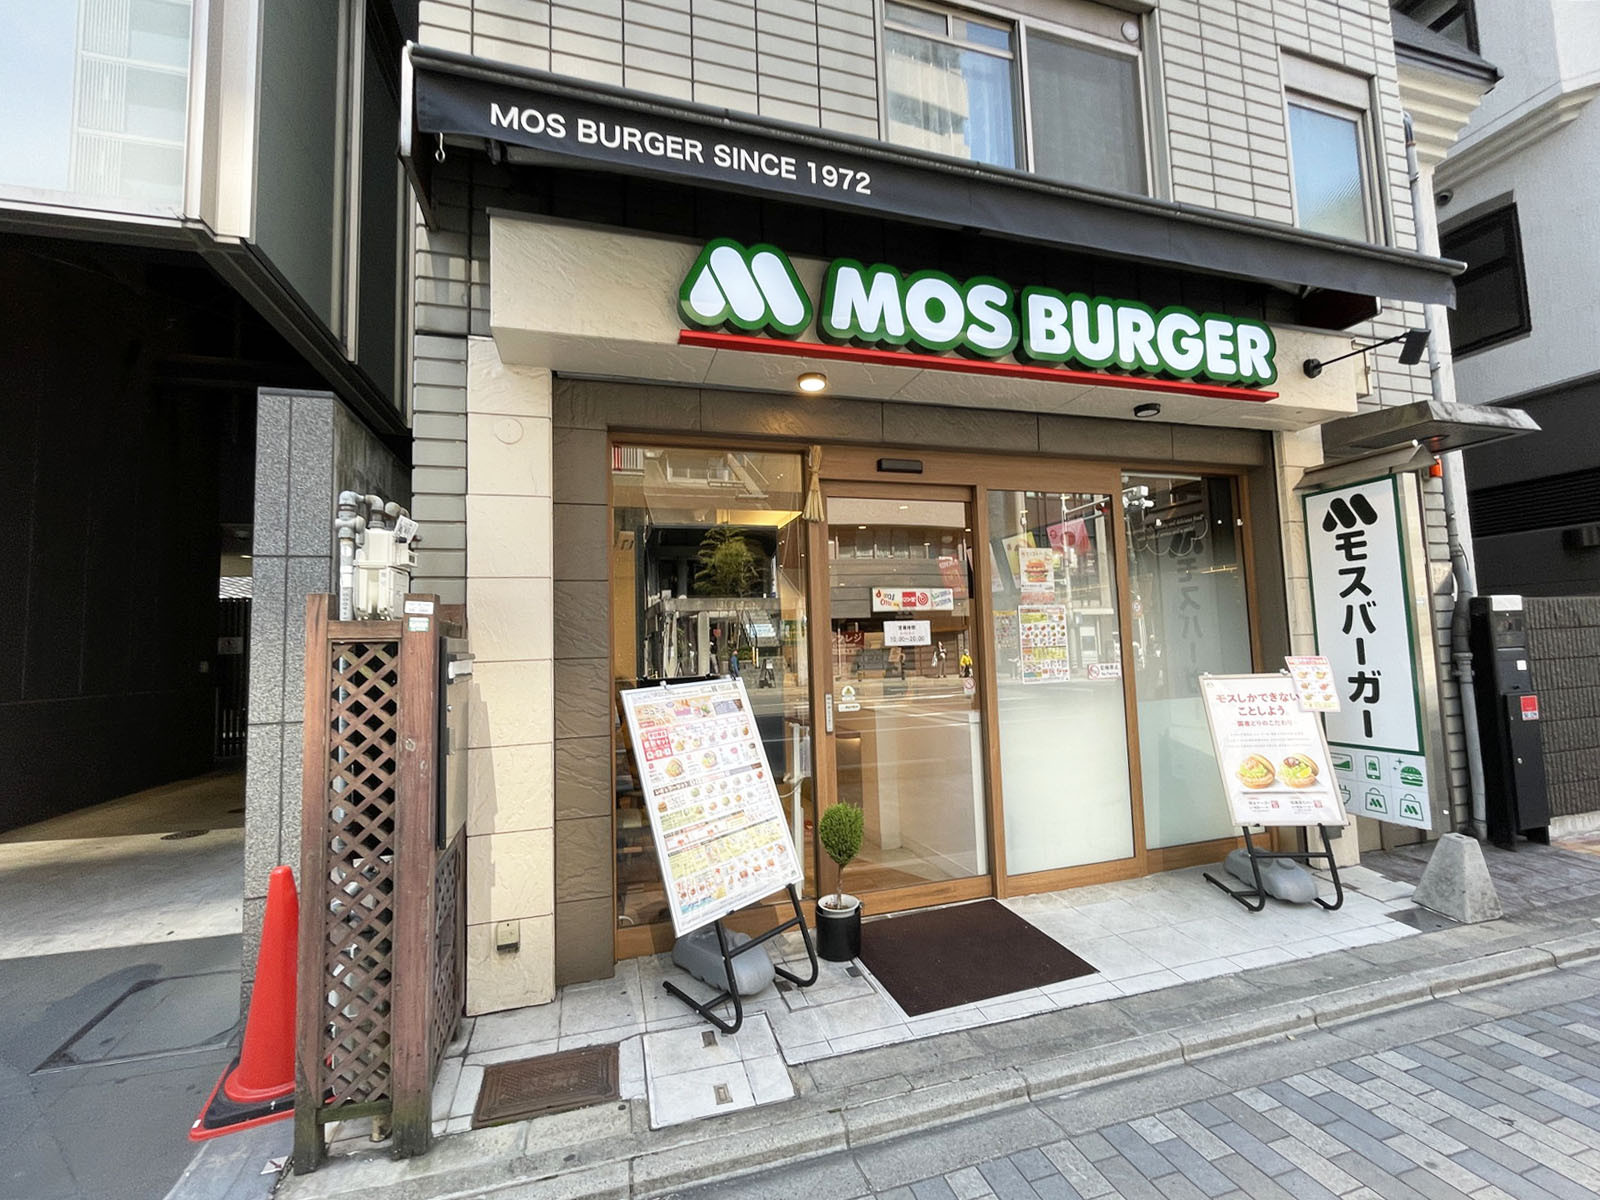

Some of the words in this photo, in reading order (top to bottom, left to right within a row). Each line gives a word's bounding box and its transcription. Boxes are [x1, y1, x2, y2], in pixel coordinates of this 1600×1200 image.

[489, 102, 567, 139] MOS
[577, 118, 705, 163] BURGER
[713, 143, 797, 180] SINCE
[806, 161, 872, 195] 1972
[830, 265, 1009, 349] MOS
[1027, 293, 1274, 380] BURGER
[1334, 530, 1383, 739] モスバーガー
[1215, 691, 1300, 704] モスしかできない
